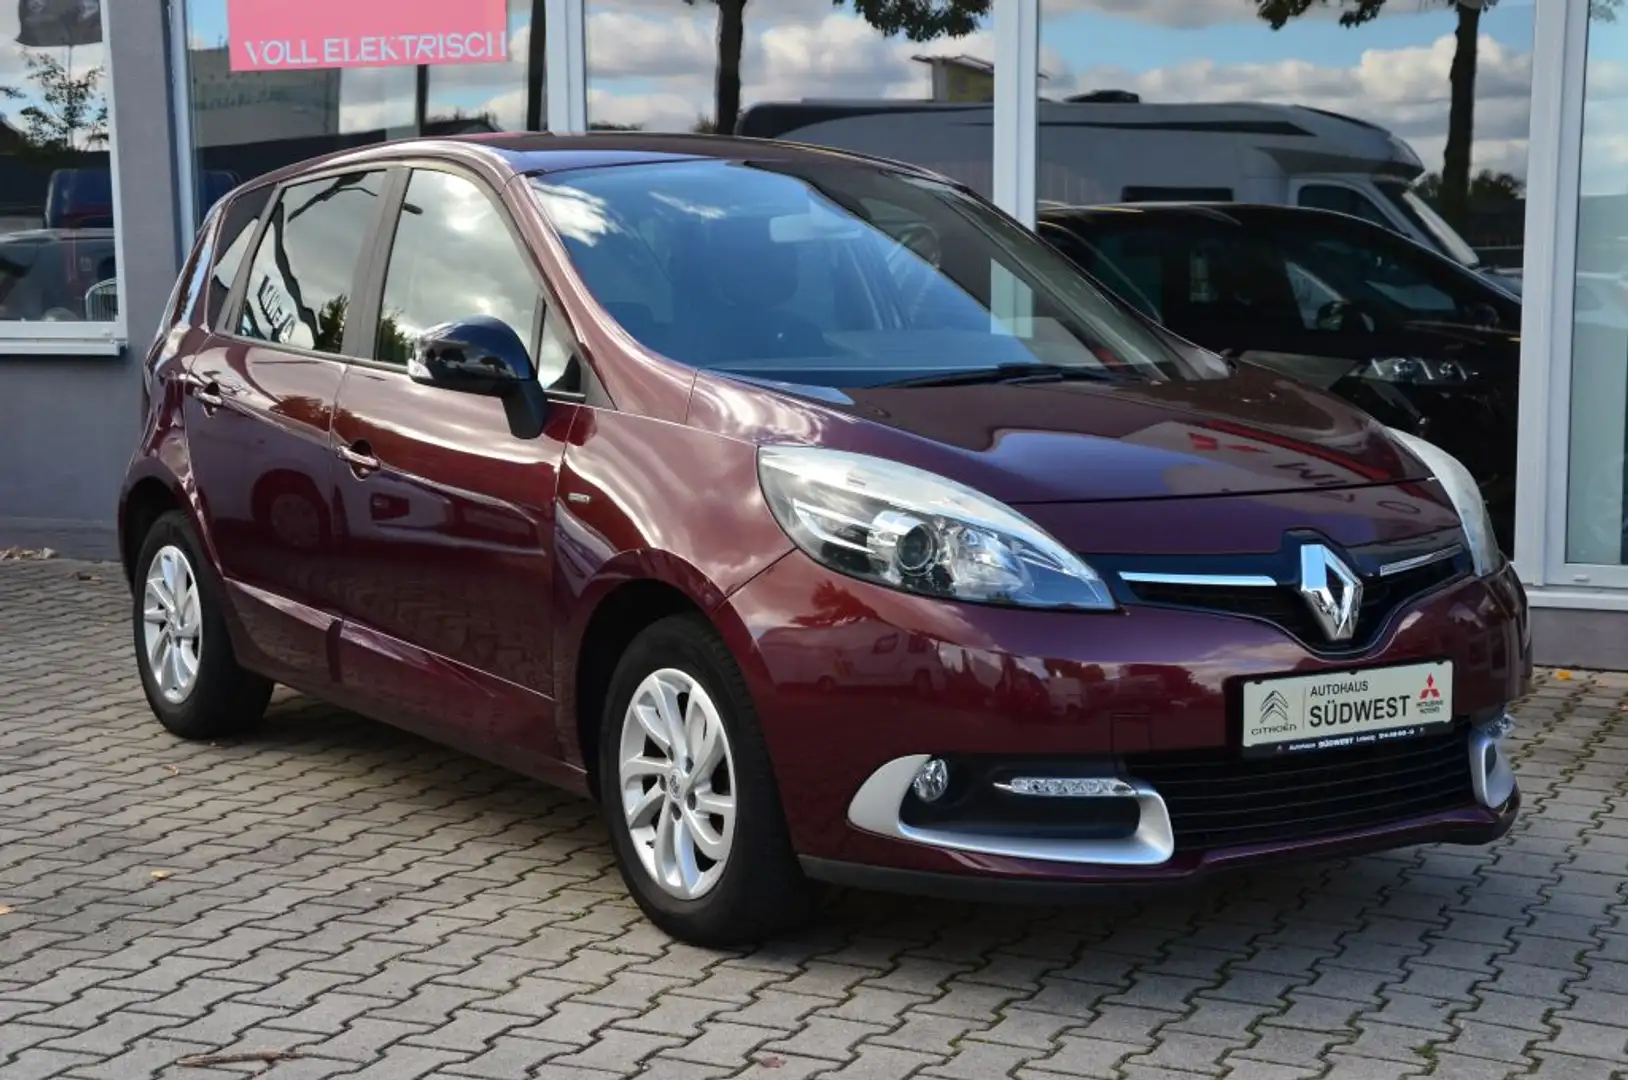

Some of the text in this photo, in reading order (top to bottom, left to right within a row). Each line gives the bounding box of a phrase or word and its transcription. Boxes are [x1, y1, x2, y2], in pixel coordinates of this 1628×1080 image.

[244, 40, 318, 65] VOLL
[1310, 681, 1369, 697] AUTOHAUS
[1310, 695, 1411, 727] SÜDWEST
